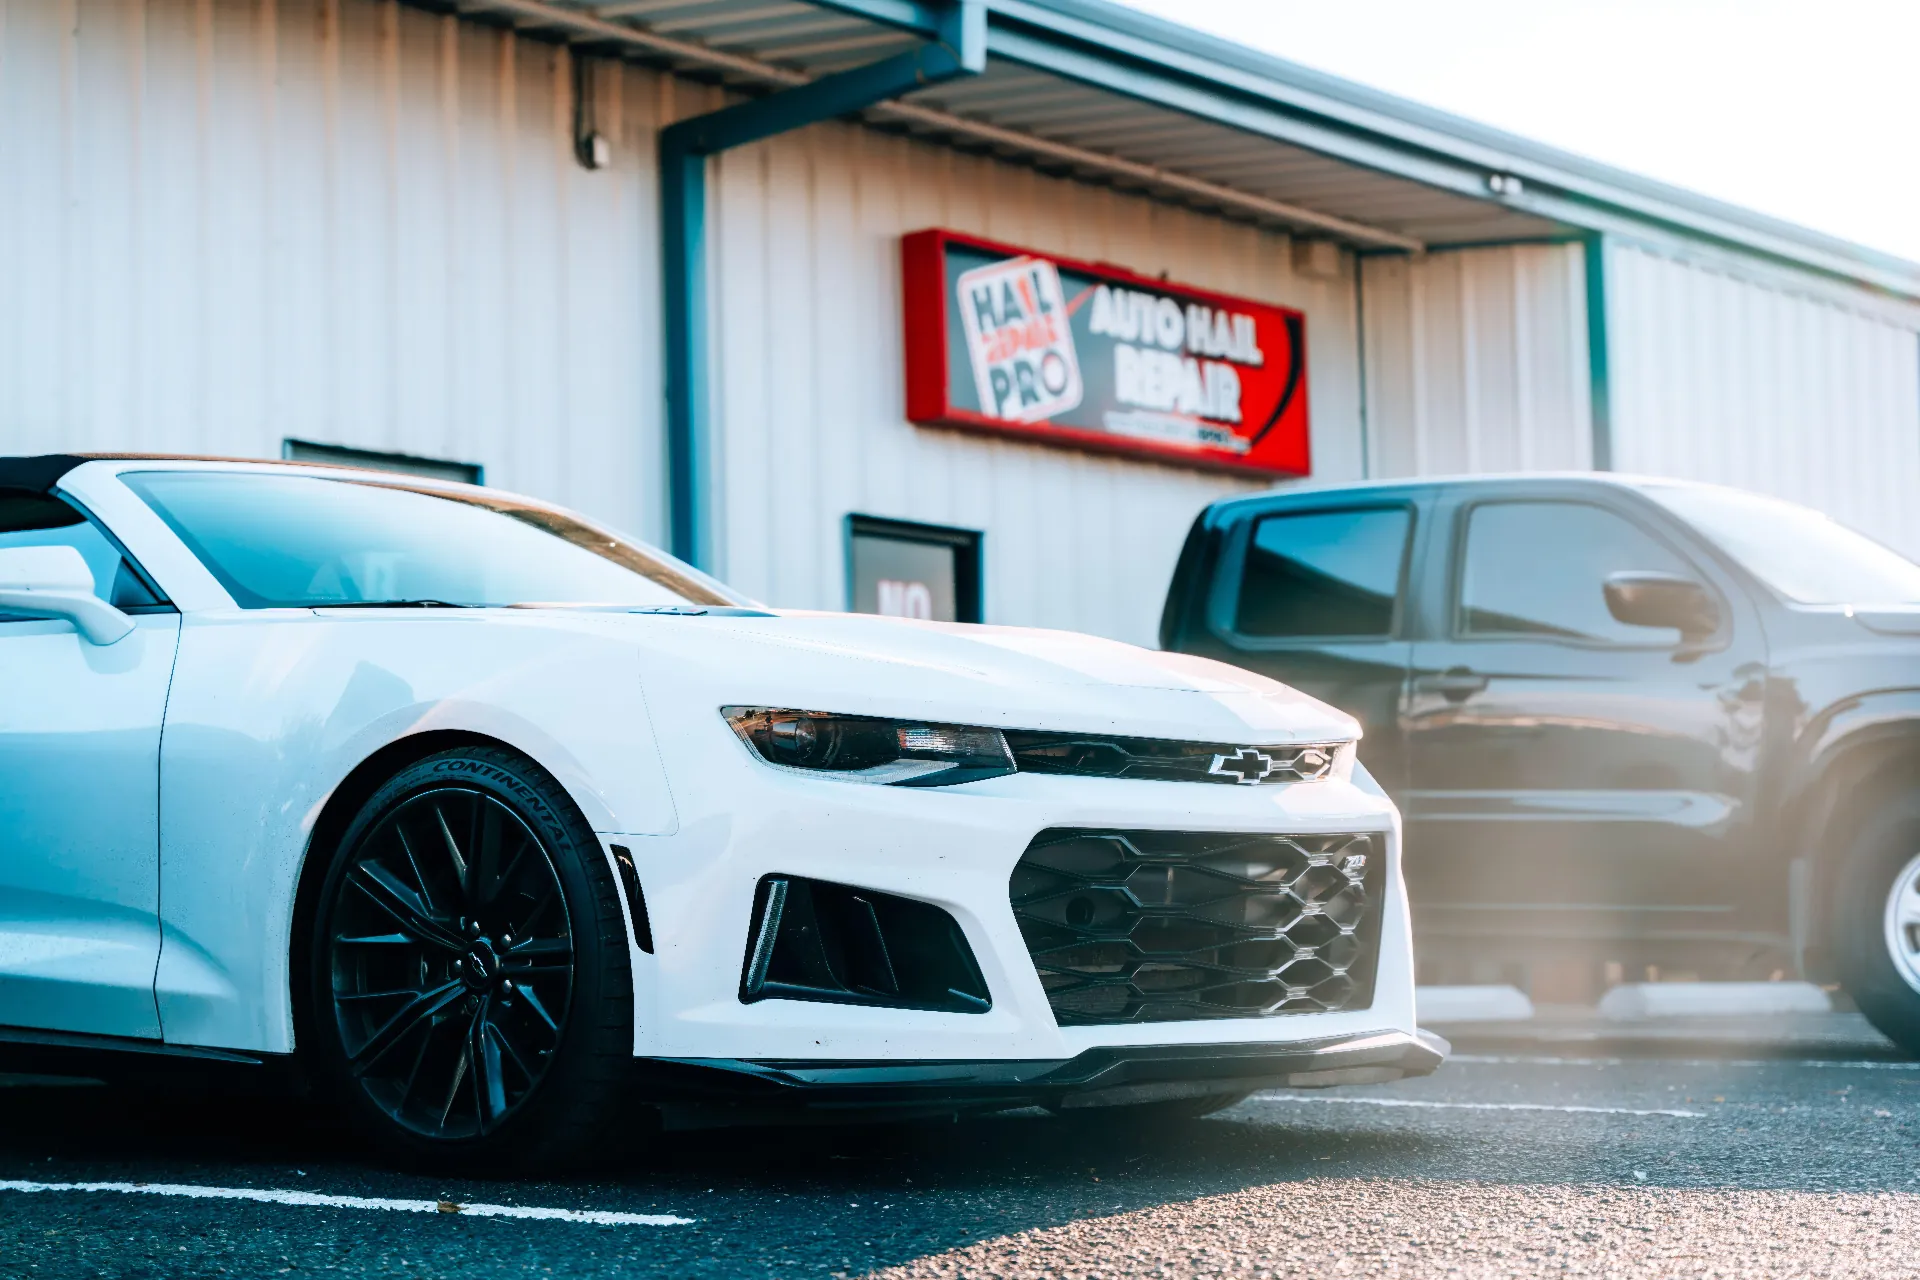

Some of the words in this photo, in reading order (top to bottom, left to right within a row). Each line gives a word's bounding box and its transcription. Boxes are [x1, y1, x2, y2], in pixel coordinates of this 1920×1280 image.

[1089, 284, 1185, 350] AUTO
[1186, 303, 1264, 365] HAIL
[989, 350, 1067, 417] PRO
[1114, 343, 1242, 423] REPAIR
[433, 760, 572, 857] CONTINENTAL
